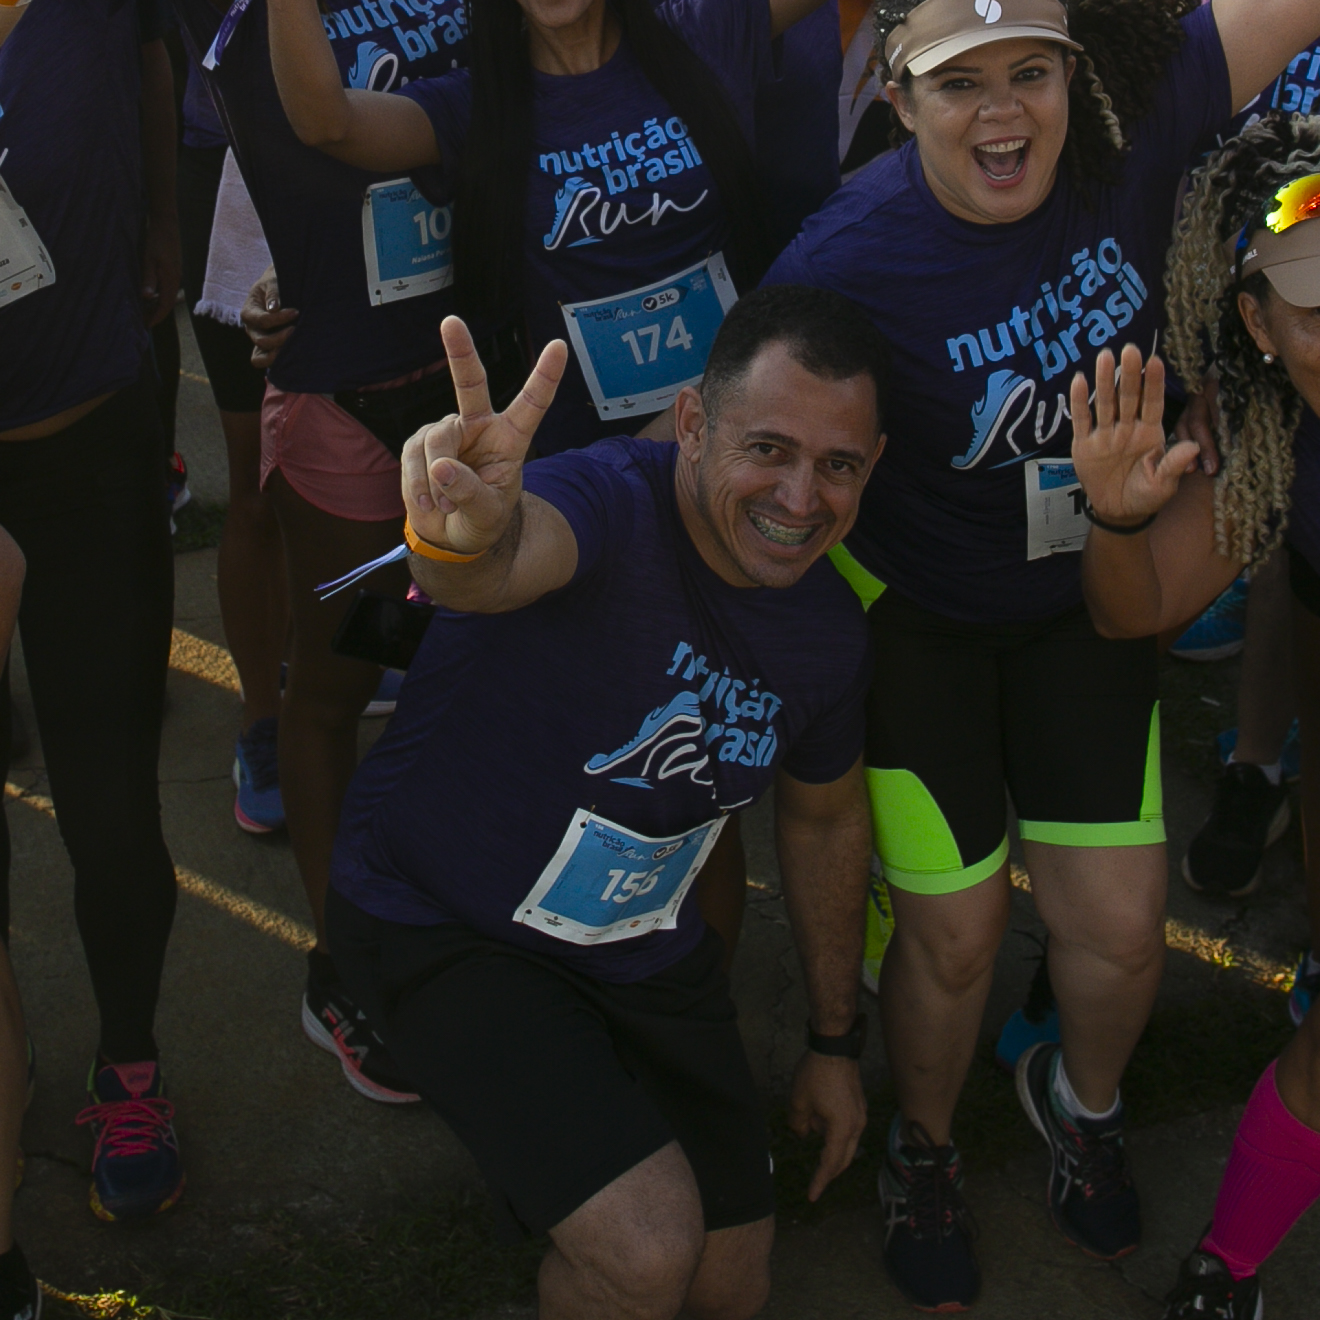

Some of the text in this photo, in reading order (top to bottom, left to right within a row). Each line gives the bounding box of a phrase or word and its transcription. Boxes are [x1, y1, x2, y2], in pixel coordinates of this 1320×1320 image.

[538, 116, 689, 176] nutrição
[601, 137, 703, 196] brasil
[544, 187, 708, 251] Run
[659, 291, 675, 305] 5k
[945, 237, 1123, 373] nutrição
[1033, 261, 1148, 381] brasil
[620, 315, 694, 366] 174
[599, 863, 666, 904] 156
